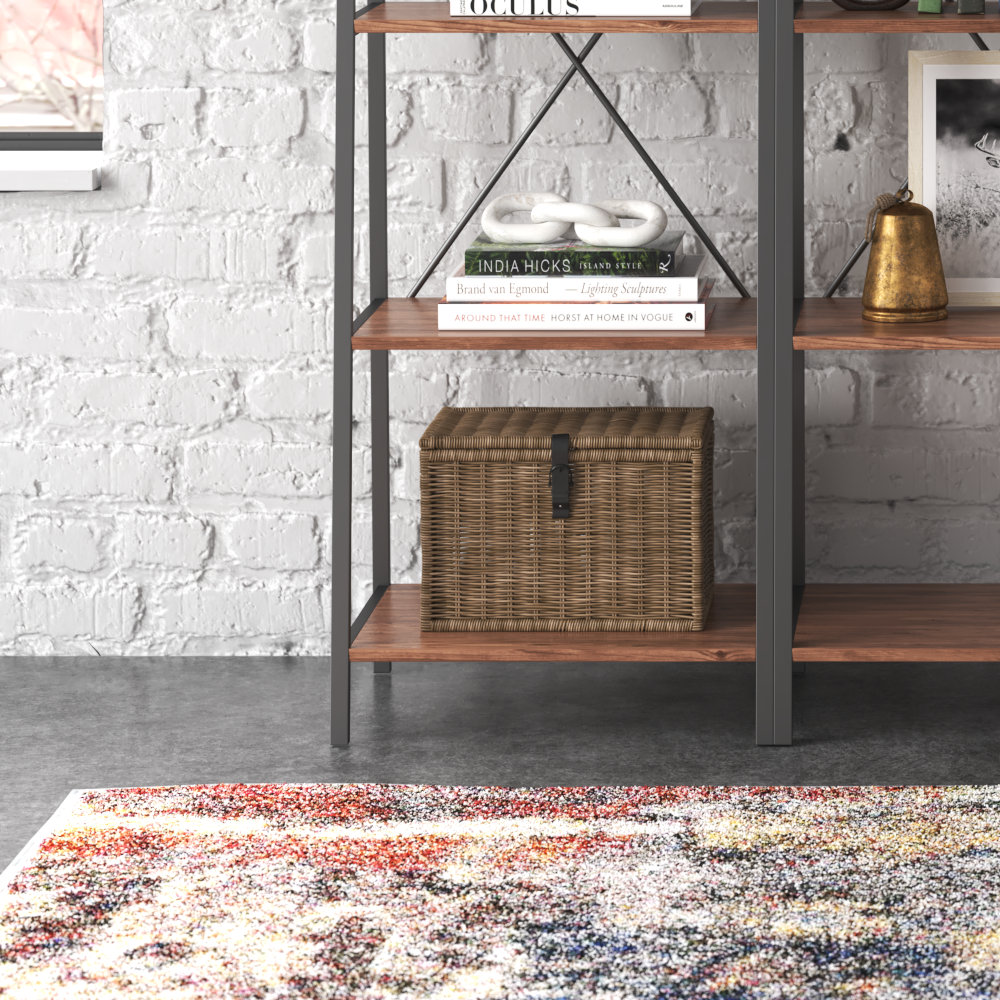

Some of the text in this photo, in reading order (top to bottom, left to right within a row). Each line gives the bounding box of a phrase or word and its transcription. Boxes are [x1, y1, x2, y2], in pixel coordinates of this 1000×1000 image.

[478, 258, 642, 273] INDIA HICKS ISLAND STYLE
[456, 283, 486, 295] Brand
[488, 286, 506, 295] van
[509, 282, 549, 297] Egmond
[580, 282, 619, 297] Lighting
[619, 282, 667, 298] Sculptures
[454, 313, 674, 322] AROUND THAT TIME HORST AT HOME IN VOGUE
